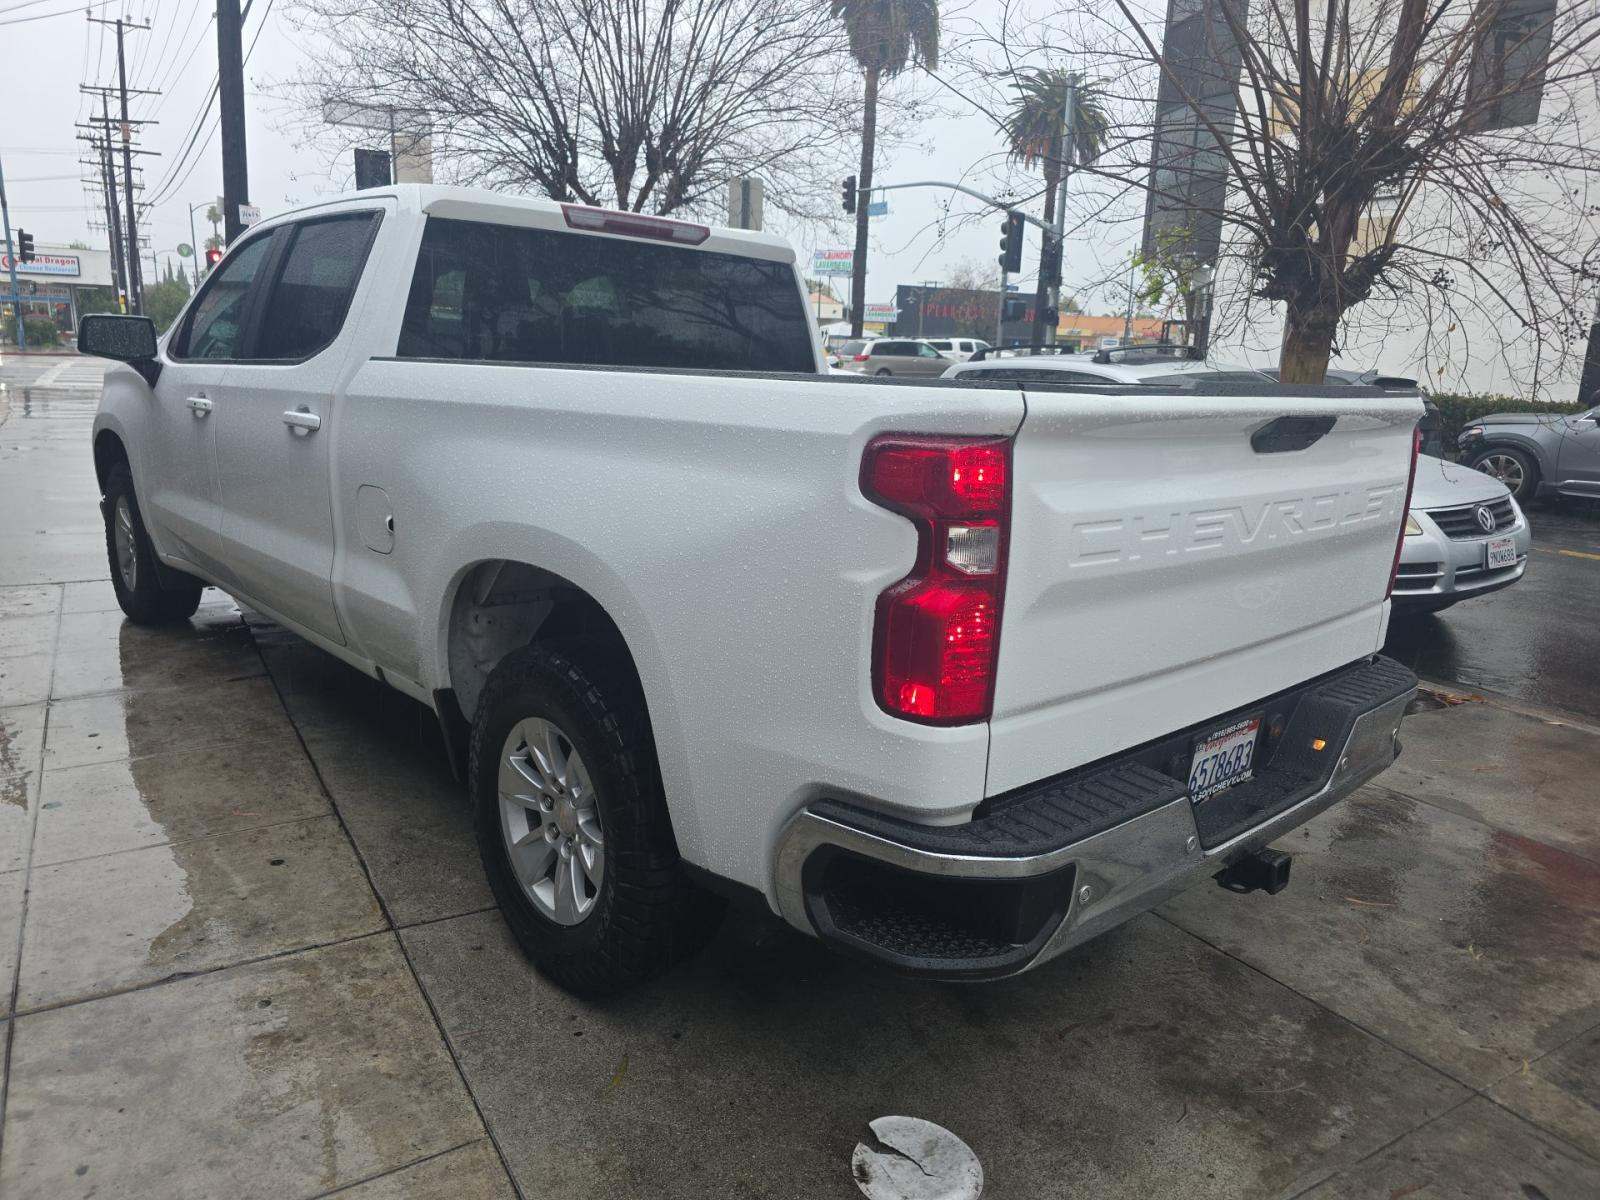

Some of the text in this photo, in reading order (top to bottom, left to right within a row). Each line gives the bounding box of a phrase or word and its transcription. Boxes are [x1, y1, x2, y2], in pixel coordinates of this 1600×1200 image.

[823, 252, 852, 260] LAUNDRY
[44, 256, 76, 265] Dragon
[44, 265, 77, 273] Restaurant
[1069, 482, 1404, 568] CHEVROLET
